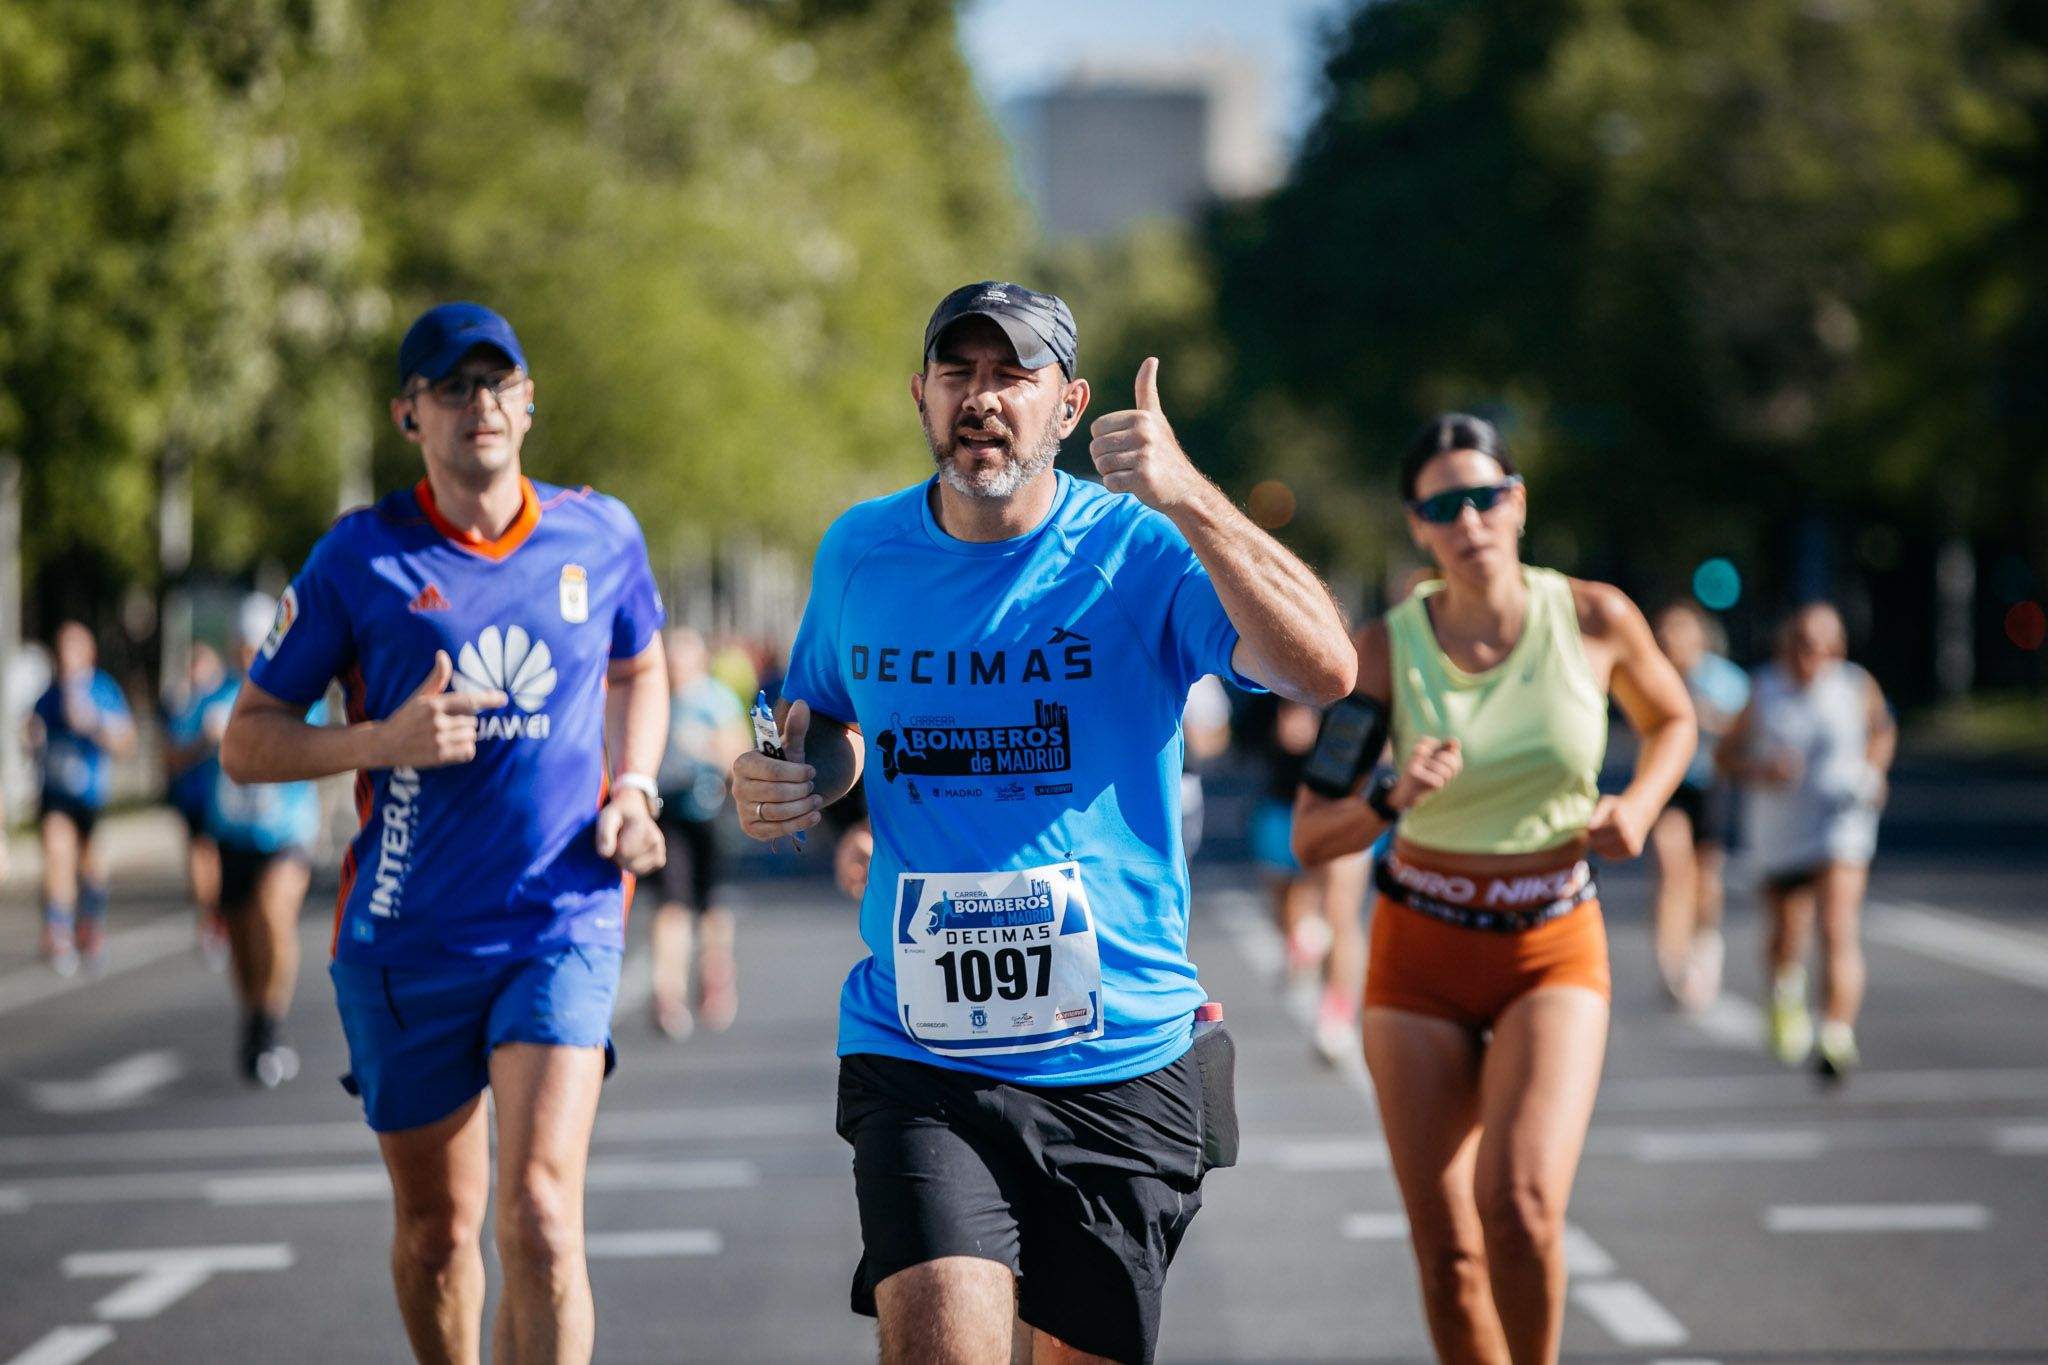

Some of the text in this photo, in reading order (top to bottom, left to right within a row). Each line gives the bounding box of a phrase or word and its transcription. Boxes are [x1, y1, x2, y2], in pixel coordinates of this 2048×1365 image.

[851, 644, 1093, 686] DECIMAS
[476, 713, 551, 741] UAWEI
[910, 713, 956, 726] CARRERA
[911, 727, 1064, 750] BOMBEROS
[970, 747, 1066, 773] de MADRID
[945, 788, 983, 798] MADRID
[954, 890, 989, 898] CARRERA
[954, 894, 1050, 914] BOMBEROS
[991, 908, 1051, 926] de MADRID
[946, 925, 1051, 945] DECIMAS
[934, 944, 1052, 1003] 1097
